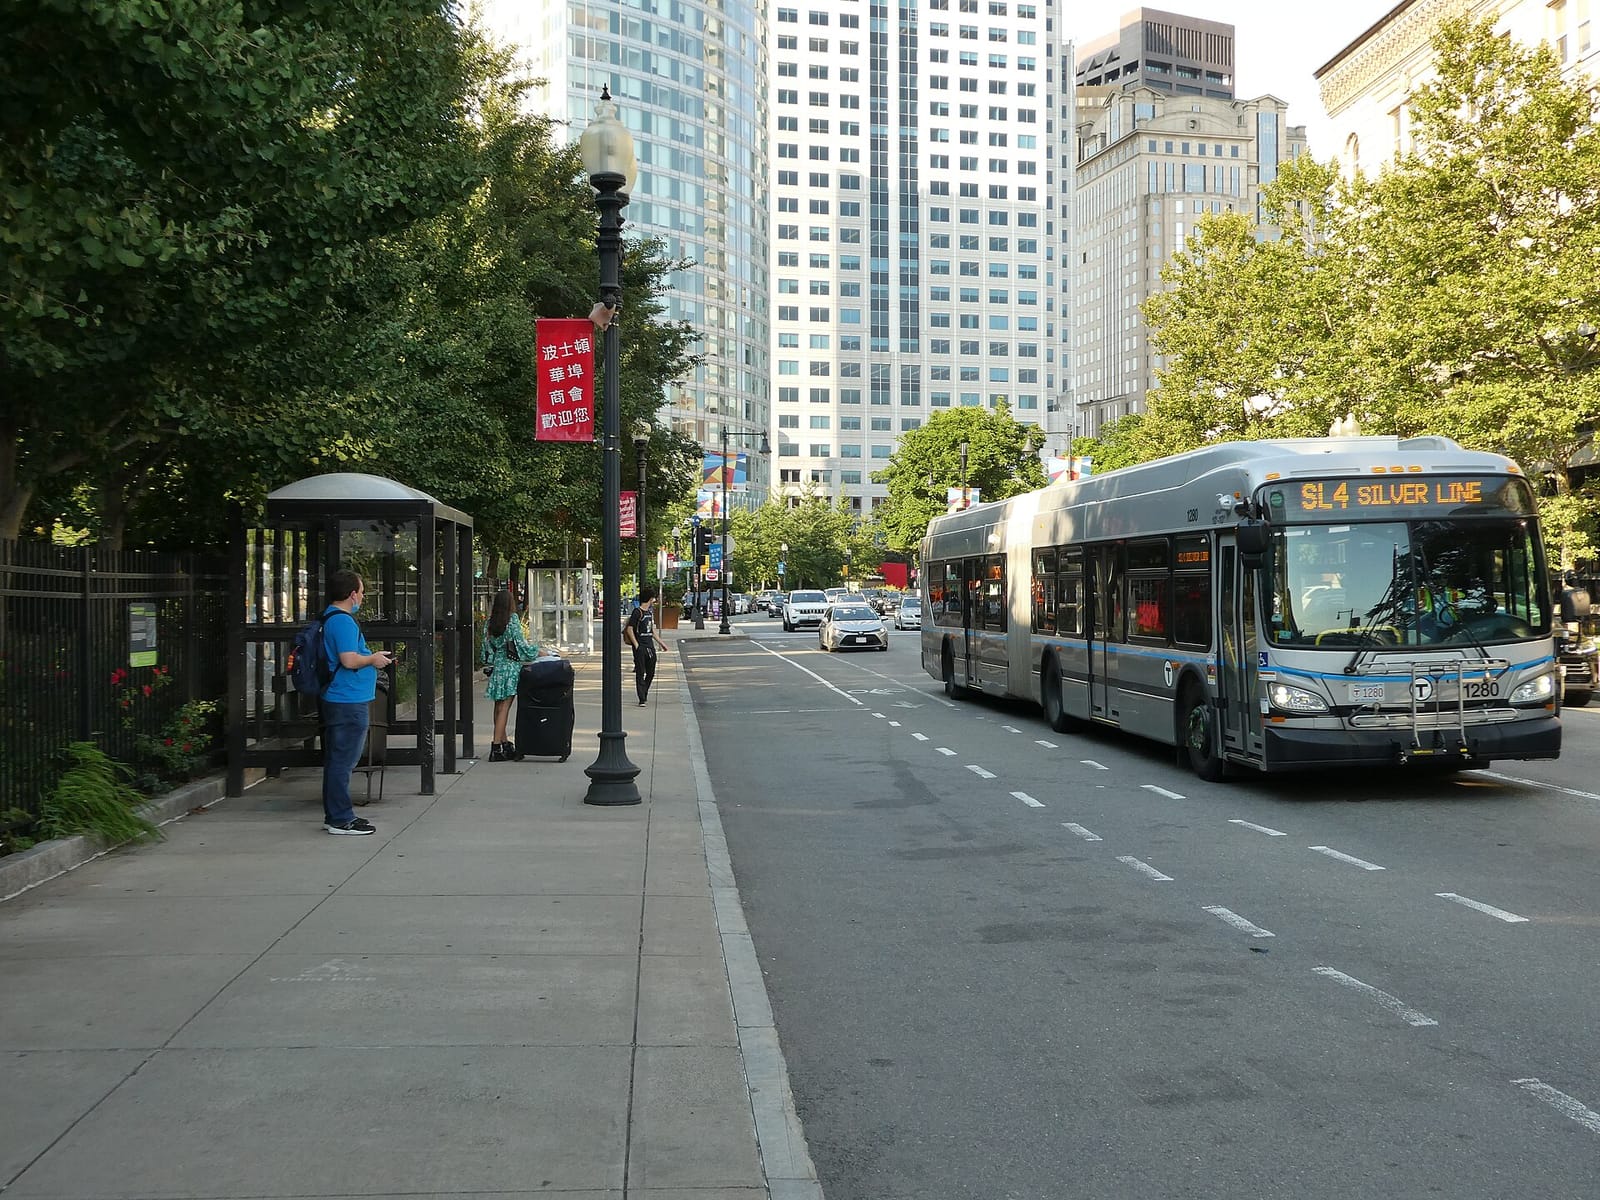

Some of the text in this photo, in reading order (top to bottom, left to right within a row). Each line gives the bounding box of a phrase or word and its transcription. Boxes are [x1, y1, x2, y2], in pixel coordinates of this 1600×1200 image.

[542, 338, 591, 361] 波士頓
[549, 363, 584, 383] 華埠
[549, 386, 584, 406] 商會
[541, 407, 590, 429] 歡迎您
[1302, 482, 1349, 510] SL4
[1358, 483, 1428, 505] SILVER
[1437, 481, 1482, 503] LINE
[1187, 508, 1199, 522] 1280
[1363, 687, 1384, 698] 1280
[1463, 682, 1500, 698] 1280
